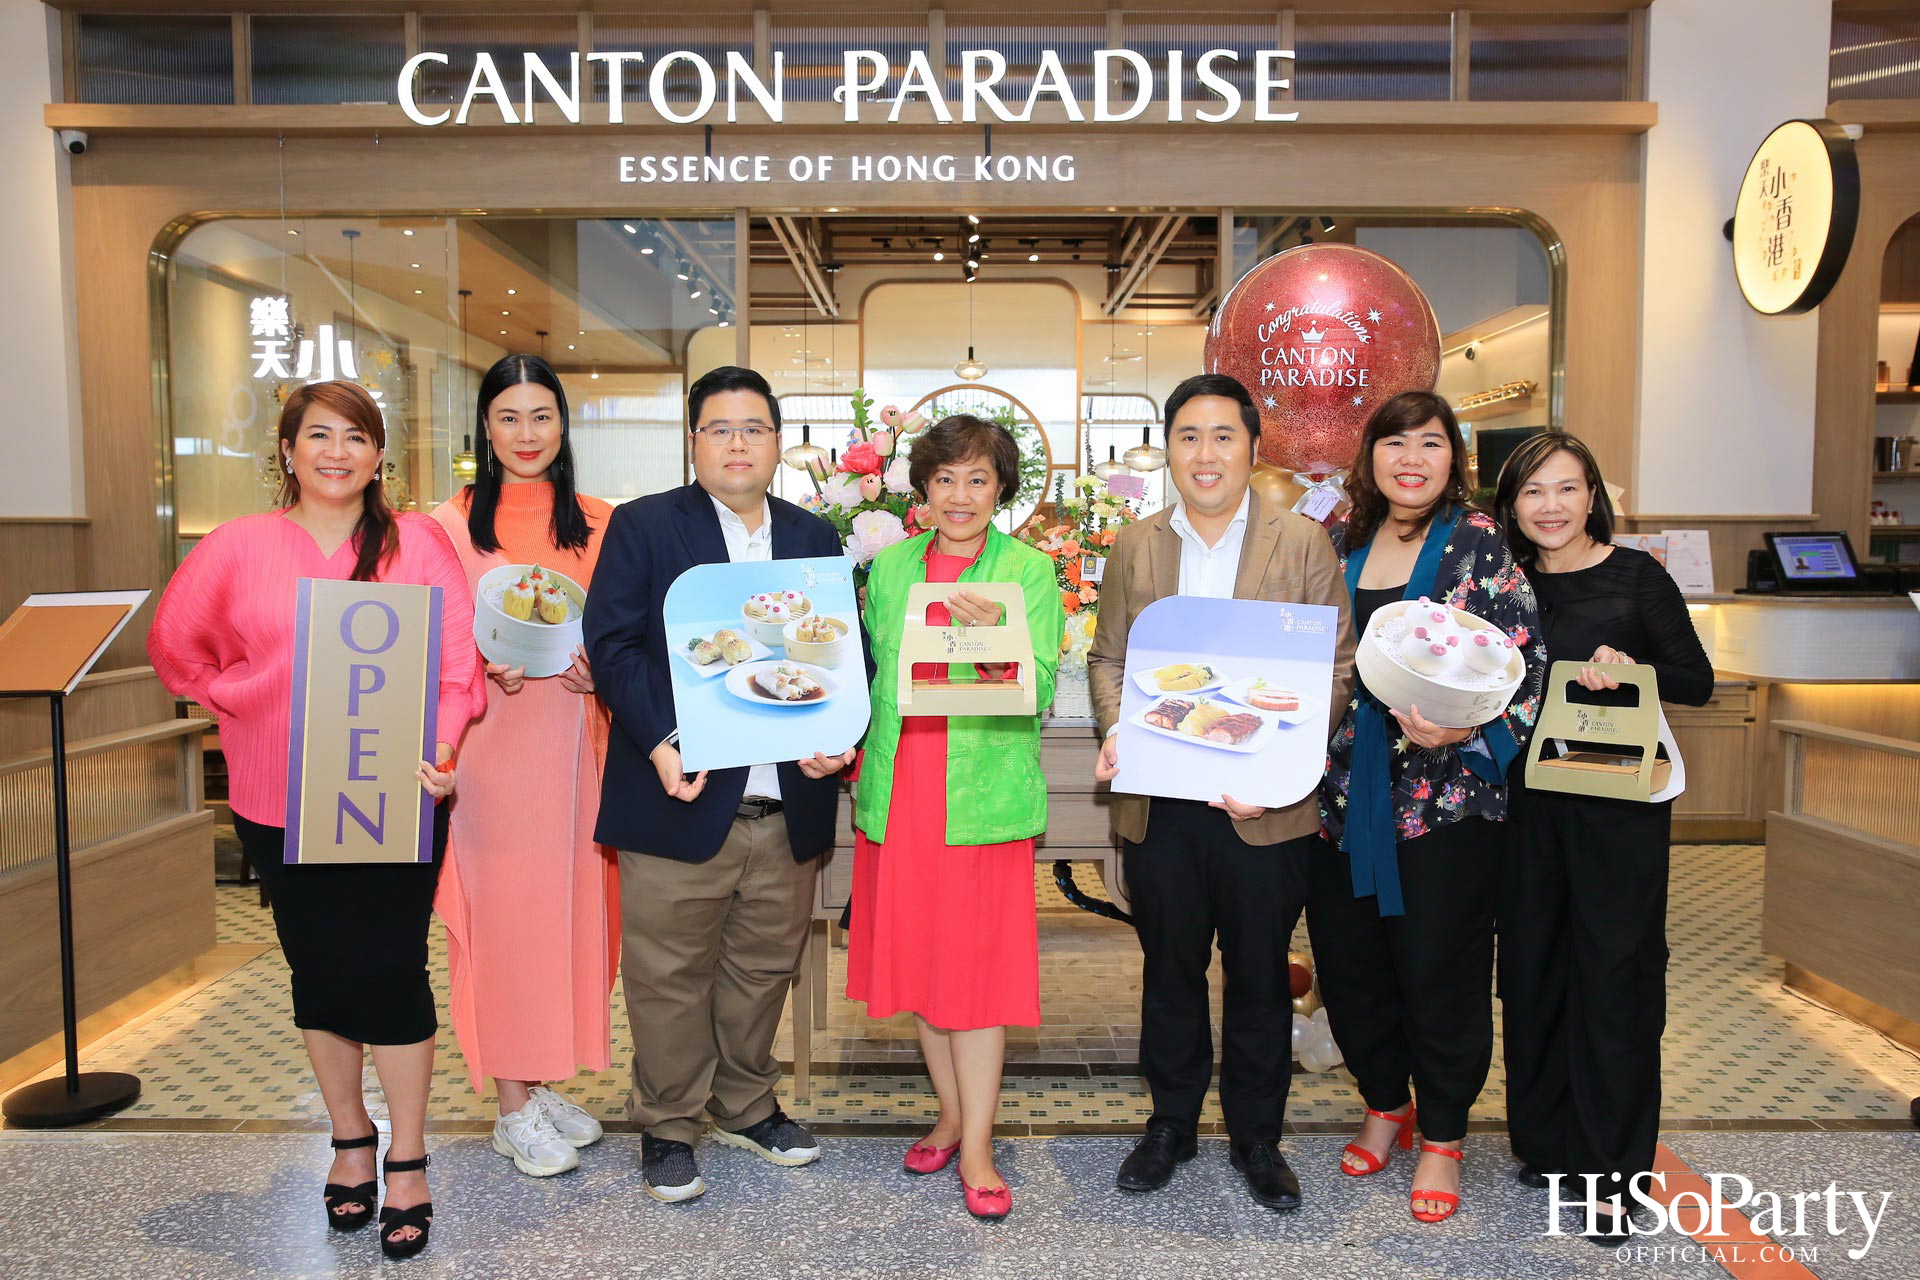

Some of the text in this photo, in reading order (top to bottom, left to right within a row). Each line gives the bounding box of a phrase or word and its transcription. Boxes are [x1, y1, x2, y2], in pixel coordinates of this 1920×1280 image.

[397, 49, 1299, 126] CANTON PARADISE
[620, 155, 1075, 183] ESSENCE OF HONG KONG
[1258, 300, 1371, 344] Congratulations
[1261, 347, 1355, 365] CANTON
[1260, 367, 1370, 387] PARADISE
[335, 600, 400, 845] OPEN
